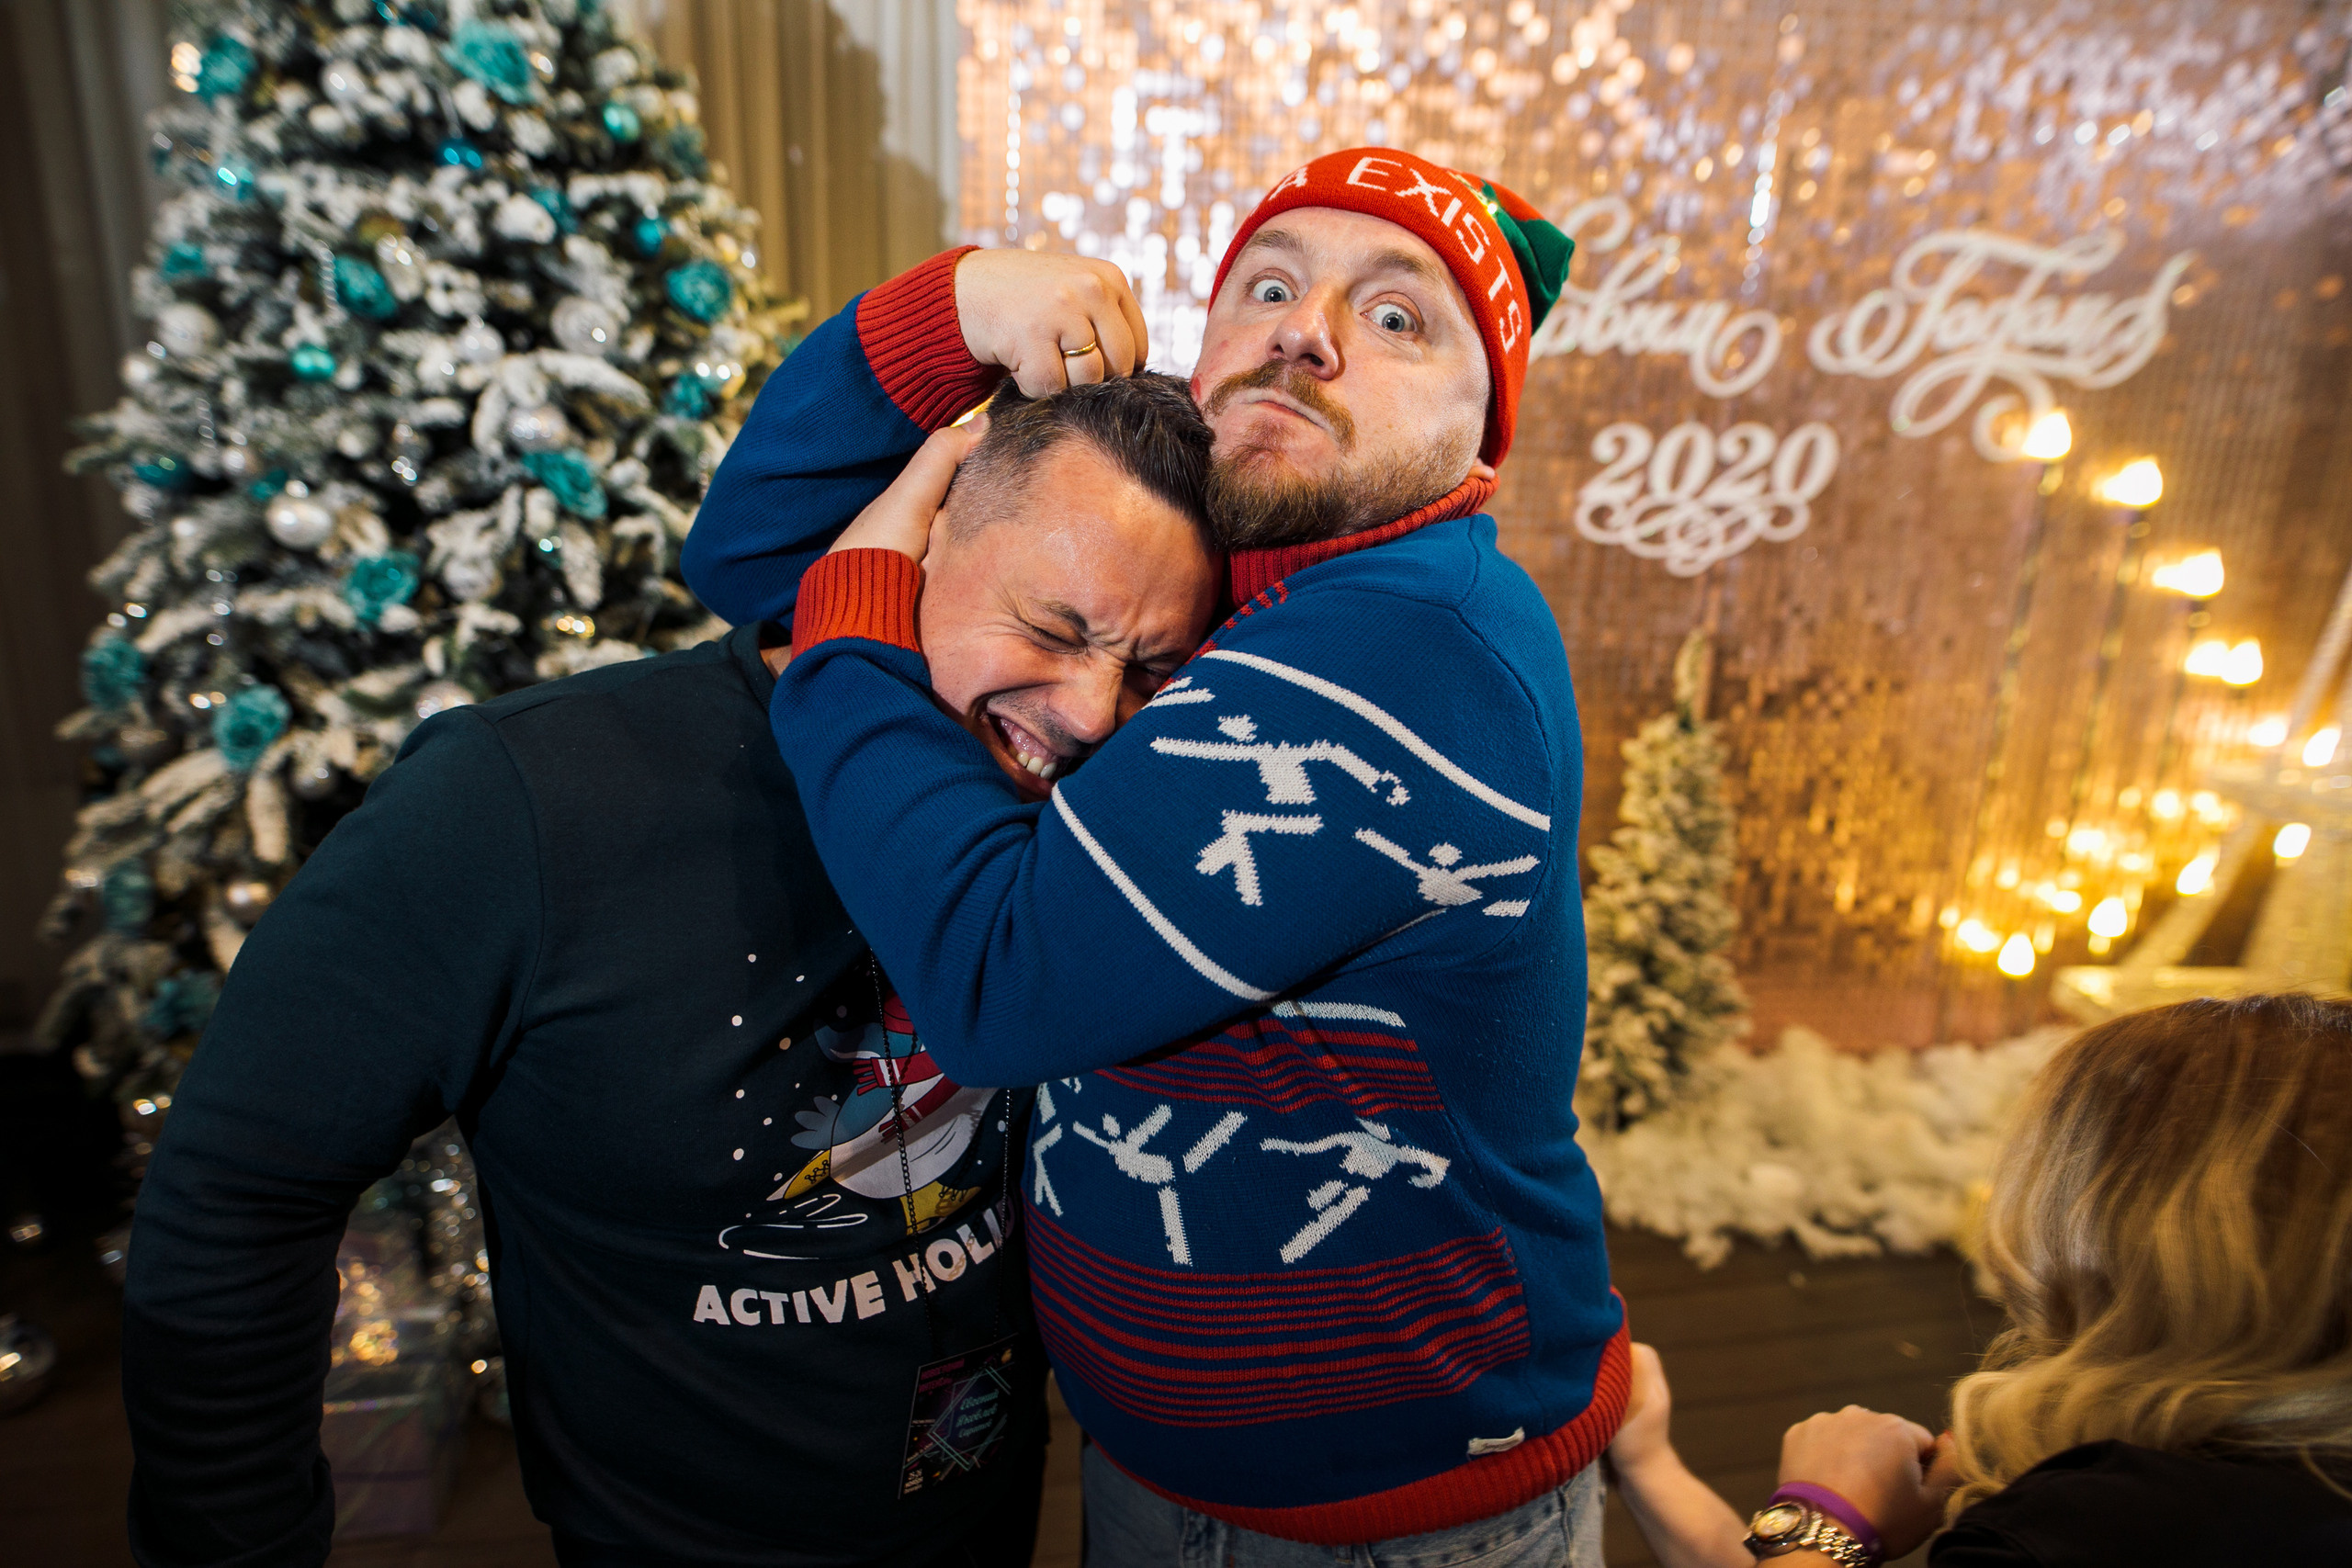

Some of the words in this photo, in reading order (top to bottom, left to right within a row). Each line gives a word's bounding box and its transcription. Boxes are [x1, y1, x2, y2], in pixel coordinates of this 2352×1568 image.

[1346, 156, 1522, 354] EXISTS
[1529, 194, 1781, 399] овым
[1581, 420, 1838, 505] 2020
[693, 1270, 887, 1326] ACTIVE
